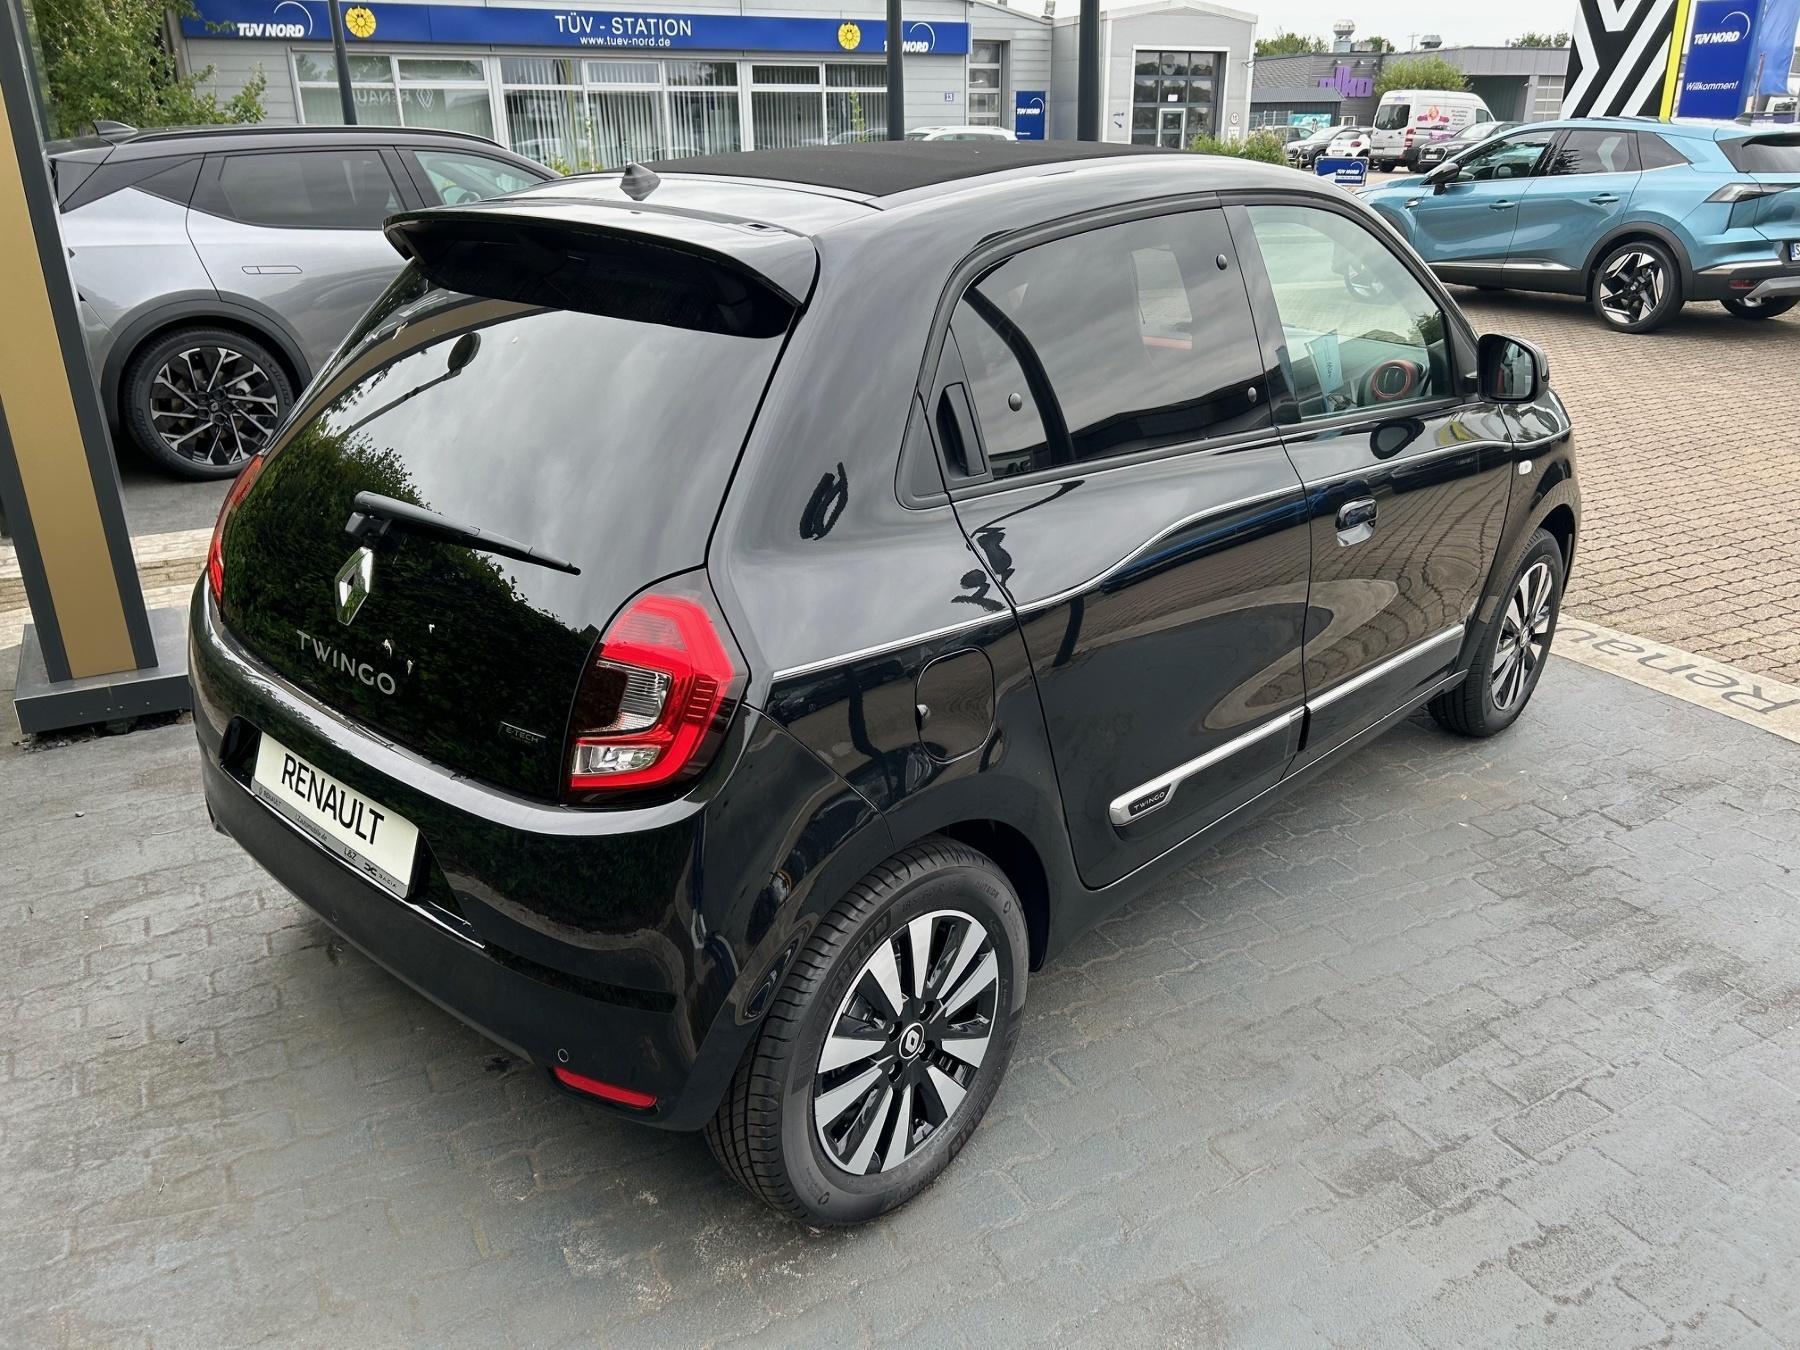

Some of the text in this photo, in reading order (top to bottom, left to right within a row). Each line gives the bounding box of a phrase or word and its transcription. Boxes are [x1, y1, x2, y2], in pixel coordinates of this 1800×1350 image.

[237, 22, 304, 38] TÜV NORD
[555, 12, 593, 33] TÜV
[611, 17, 692, 36] STATION
[579, 35, 671, 47] www.tuev-nord.de
[902, 41, 929, 52] NORD
[1694, 31, 1740, 44] TÜV NORD
[1686, 80, 1739, 91] Willkommen!
[296, 630, 397, 695] TWINGO
[1554, 626, 1800, 715] Renau
[281, 753, 384, 845] RENAULT
[1133, 791, 1165, 811] TWINGO
